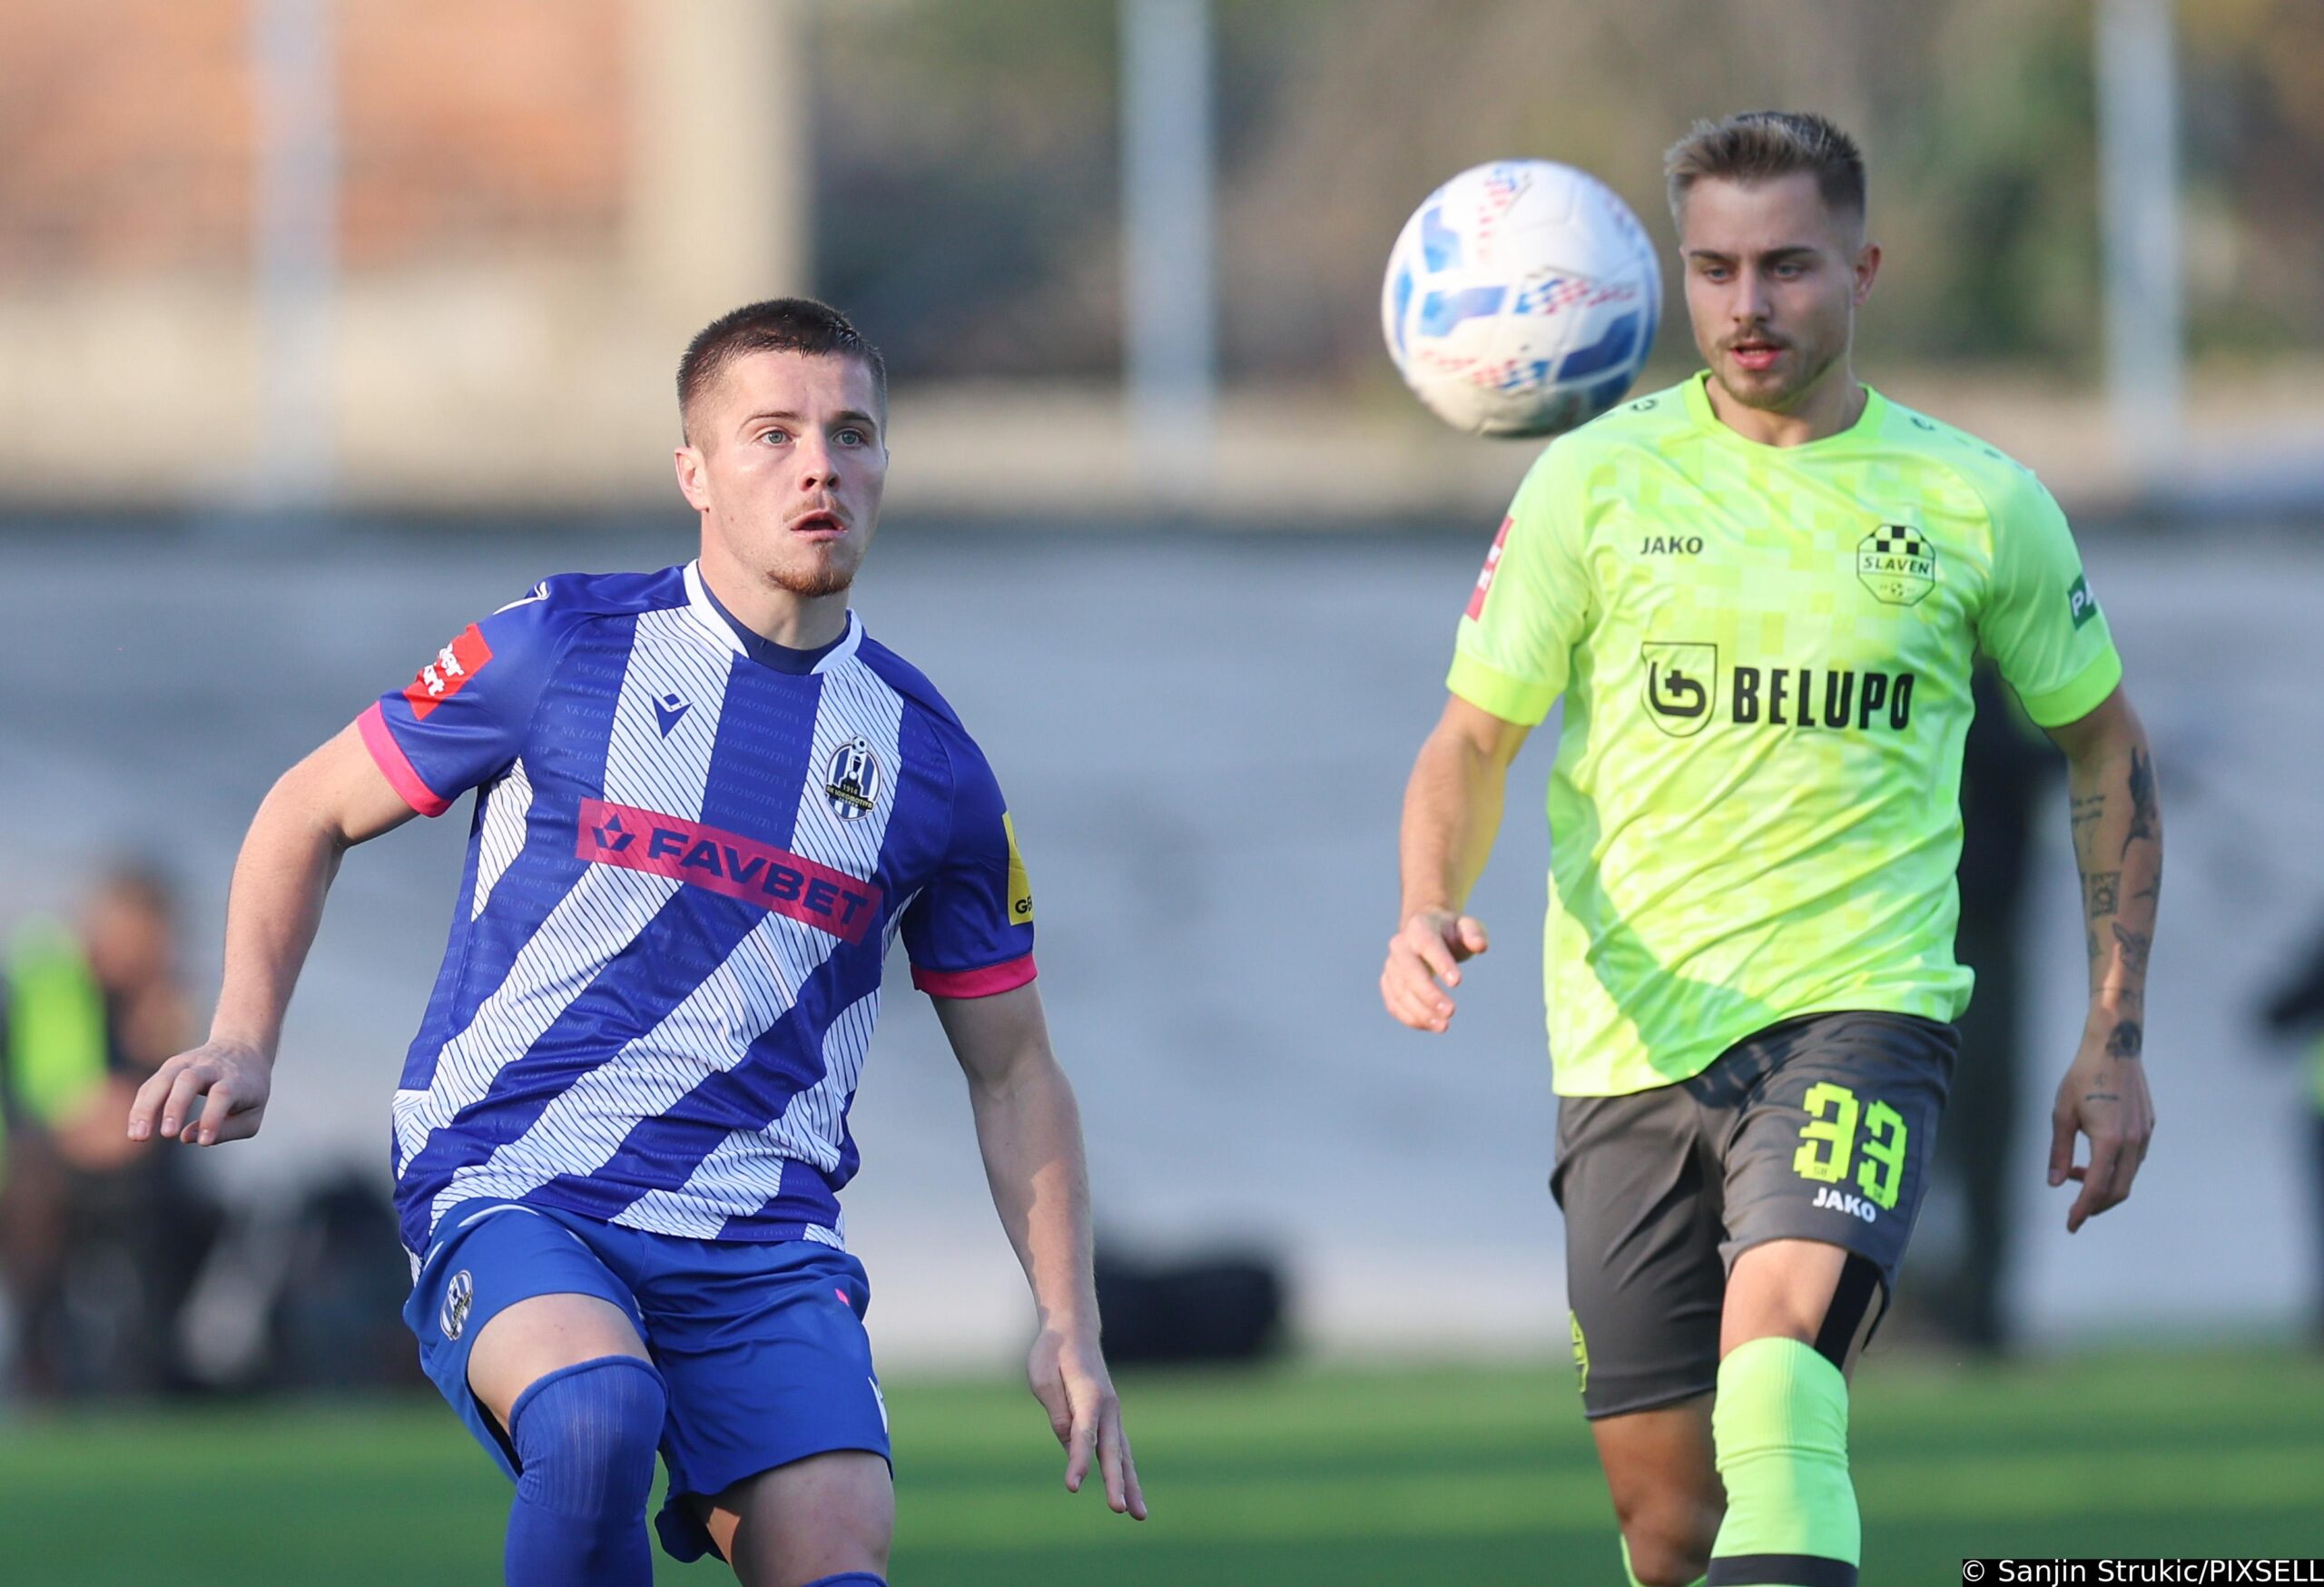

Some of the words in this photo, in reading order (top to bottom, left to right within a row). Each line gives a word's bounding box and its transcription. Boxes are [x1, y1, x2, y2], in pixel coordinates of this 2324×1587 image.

[1640, 536, 1703, 556] JAKO
[1864, 556, 1930, 575] SLAVEN
[1733, 666, 1915, 730] BELUPO
[648, 826, 871, 926] FAVBET
[1794, 1081, 1908, 1210] 33
[1813, 1187, 1876, 1223] JAKO
